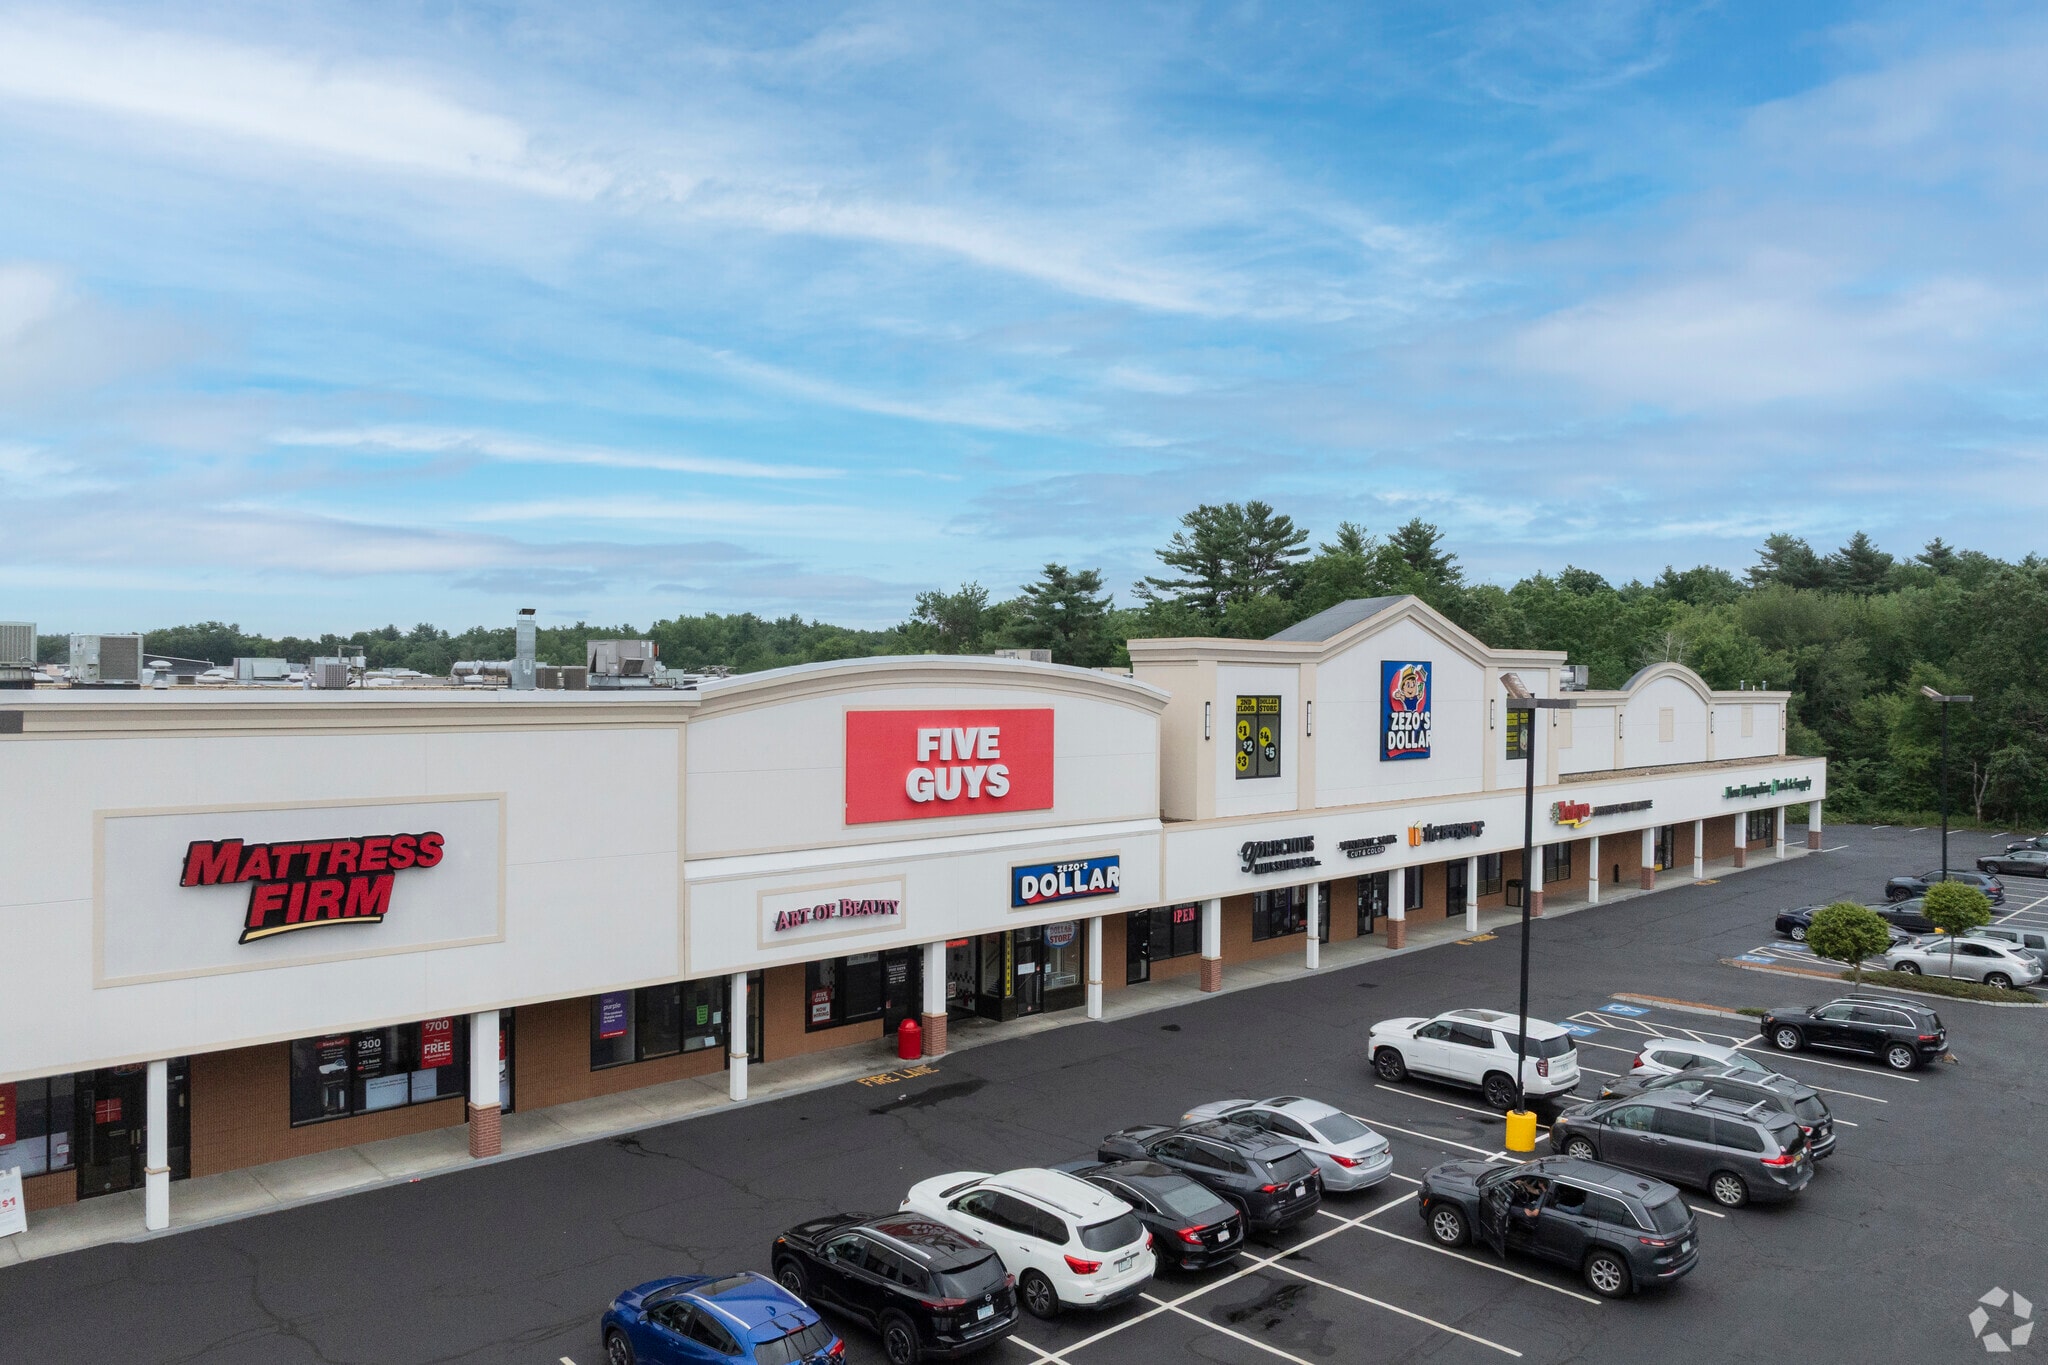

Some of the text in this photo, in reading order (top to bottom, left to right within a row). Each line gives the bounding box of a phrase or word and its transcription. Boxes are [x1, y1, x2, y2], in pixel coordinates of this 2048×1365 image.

[1391, 711, 1430, 731] ZEZO'S
[1238, 725, 1248, 736] $1
[1260, 731, 1269, 742] $4
[917, 727, 1000, 762] FIVE
[1387, 729, 1432, 750] DOLLAR
[1243, 740, 1253, 752] $2
[1265, 747, 1275, 758] $5
[1237, 756, 1247, 767] $3
[905, 764, 1010, 803] GUYS
[1350, 850, 1361, 858] CUT
[1367, 846, 1384, 855] COLOR
[182, 832, 445, 887] MATTRESS
[1056, 862, 1088, 873] ZEZO'S
[1021, 866, 1120, 900] DOLLAR
[247, 874, 395, 928] FIRM
[1050, 933, 1072, 944] STORE
[603, 1002, 621, 1011] purple
[425, 1019, 450, 1031] $700
[358, 1038, 381, 1050] $300
[424, 1041, 451, 1055] FREE
[857, 1063, 940, 1088] FIRE LANE
